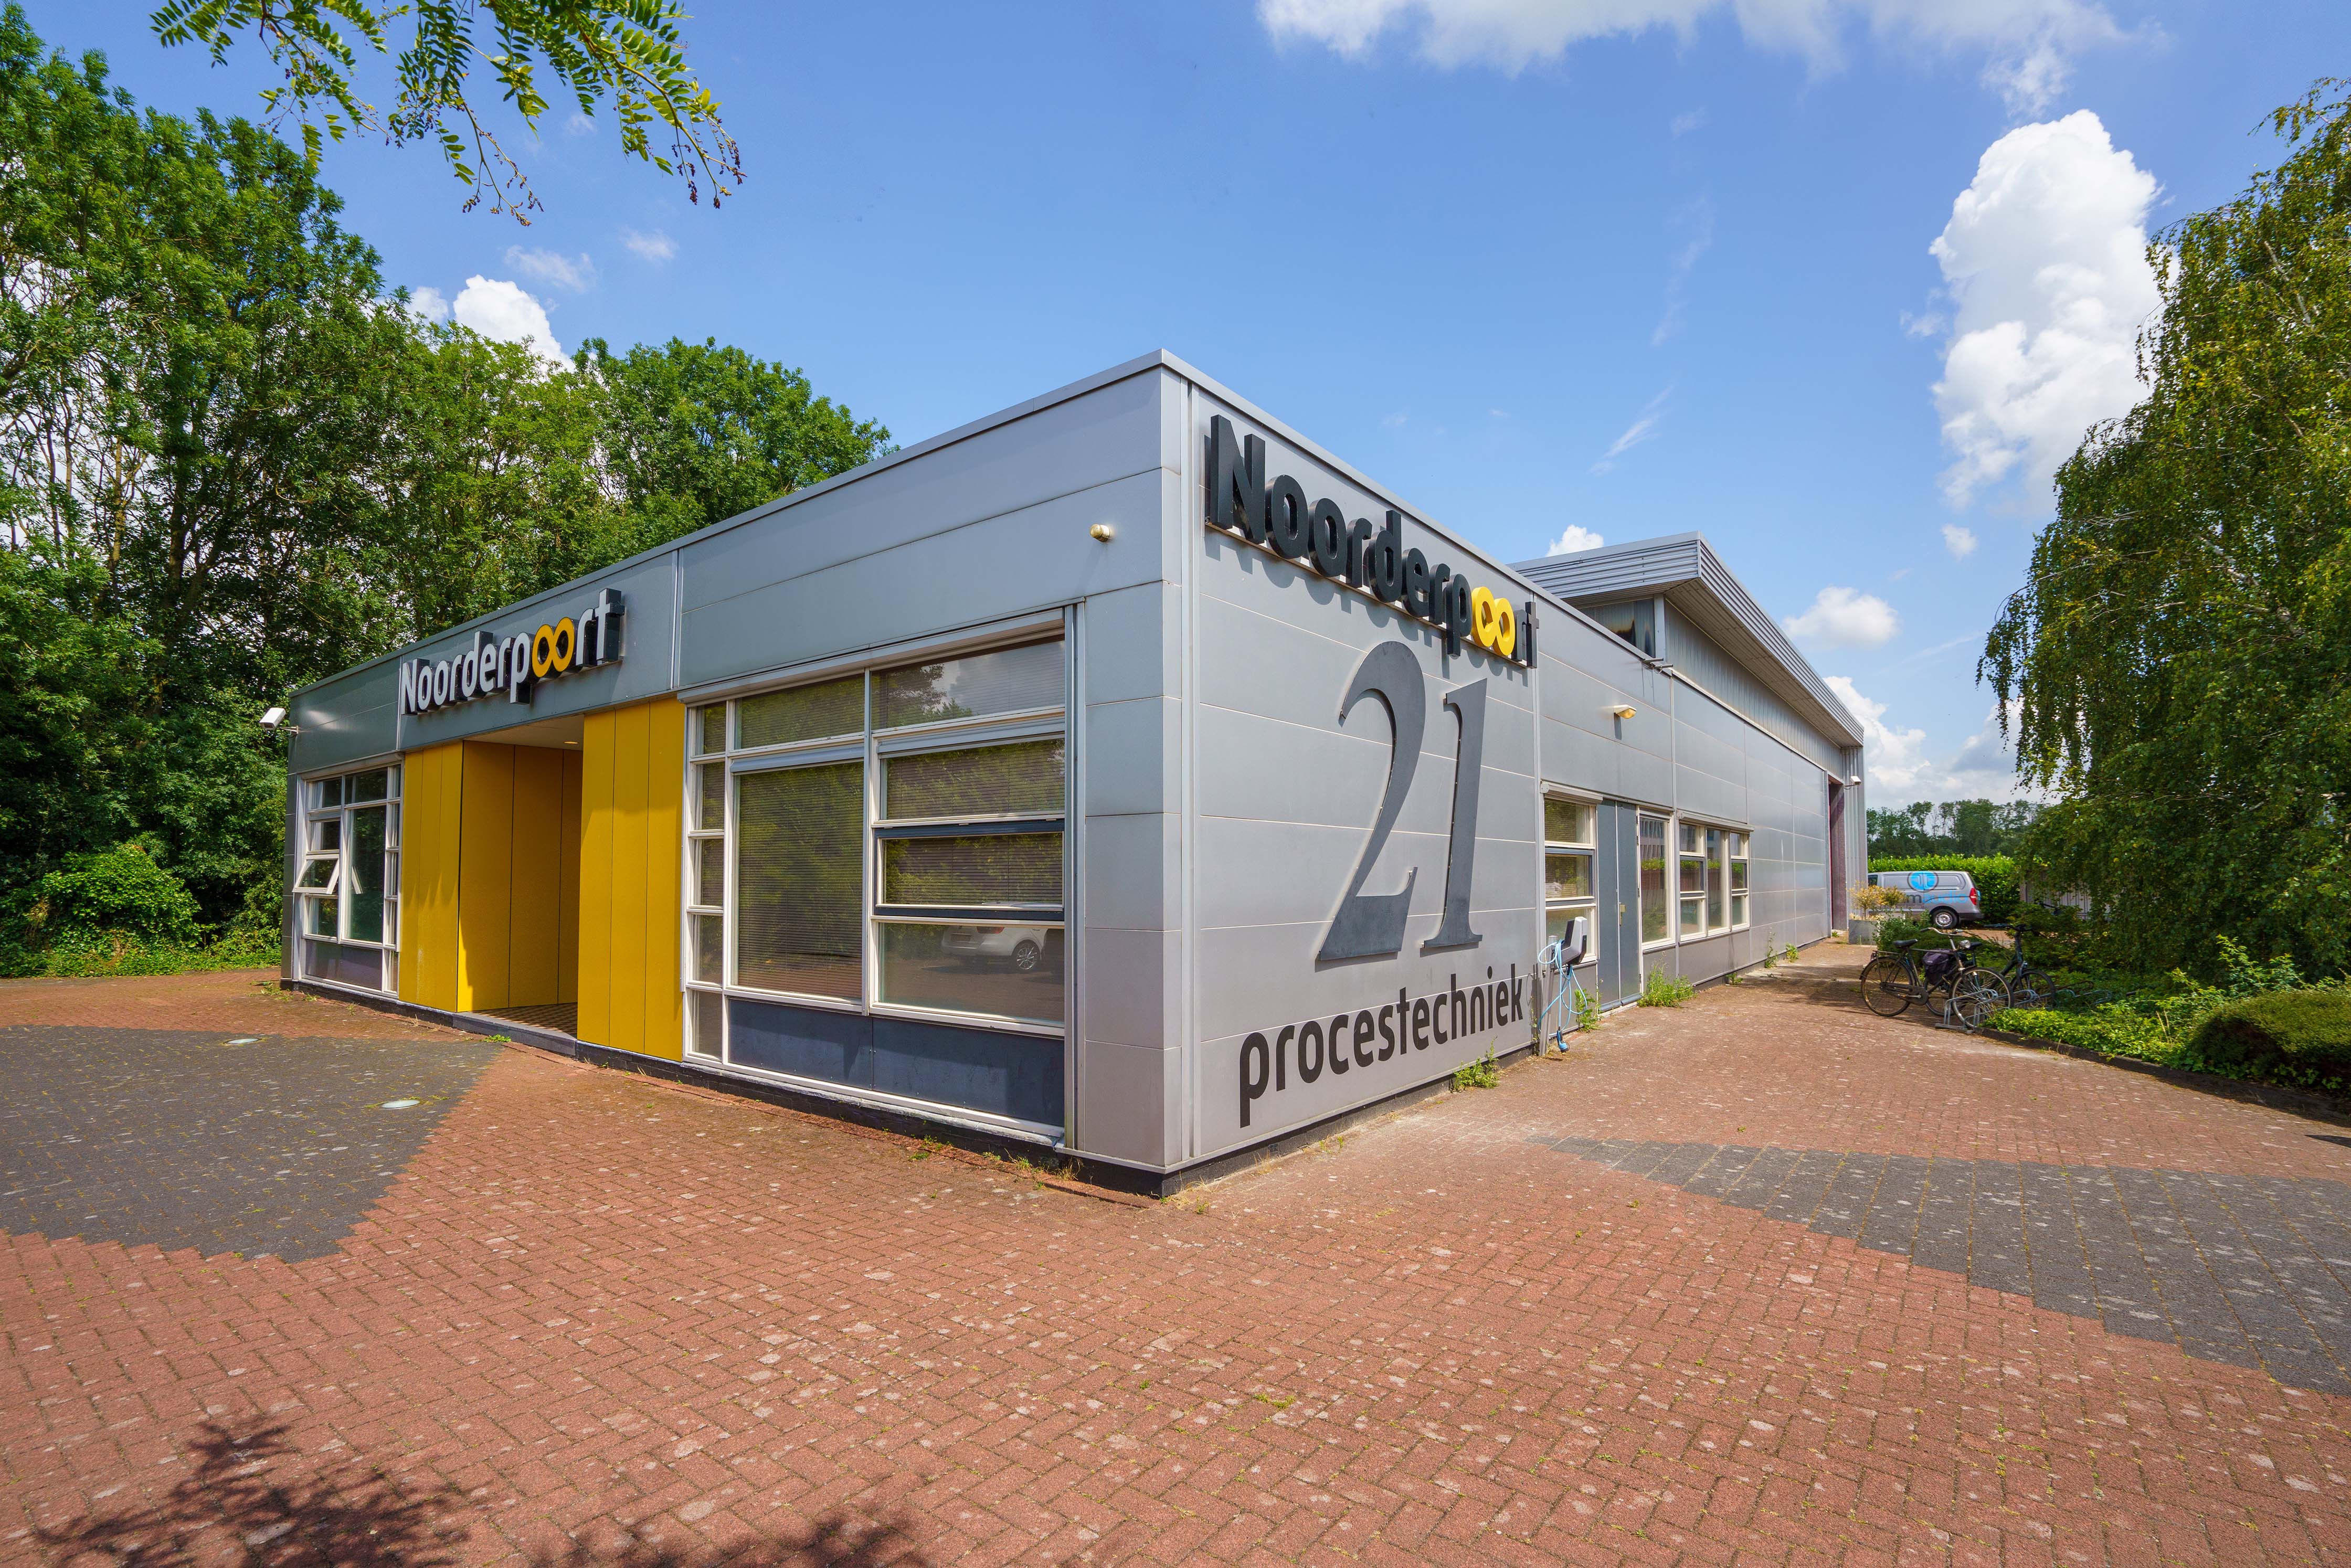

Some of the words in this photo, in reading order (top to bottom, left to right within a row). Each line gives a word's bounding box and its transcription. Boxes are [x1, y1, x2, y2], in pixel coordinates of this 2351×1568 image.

[1210, 414, 1539, 669] Noorderpoort
[401, 587, 625, 716] Noorderpoort
[1318, 641, 1487, 961] 21
[1240, 963, 1523, 1129] procestechniek
